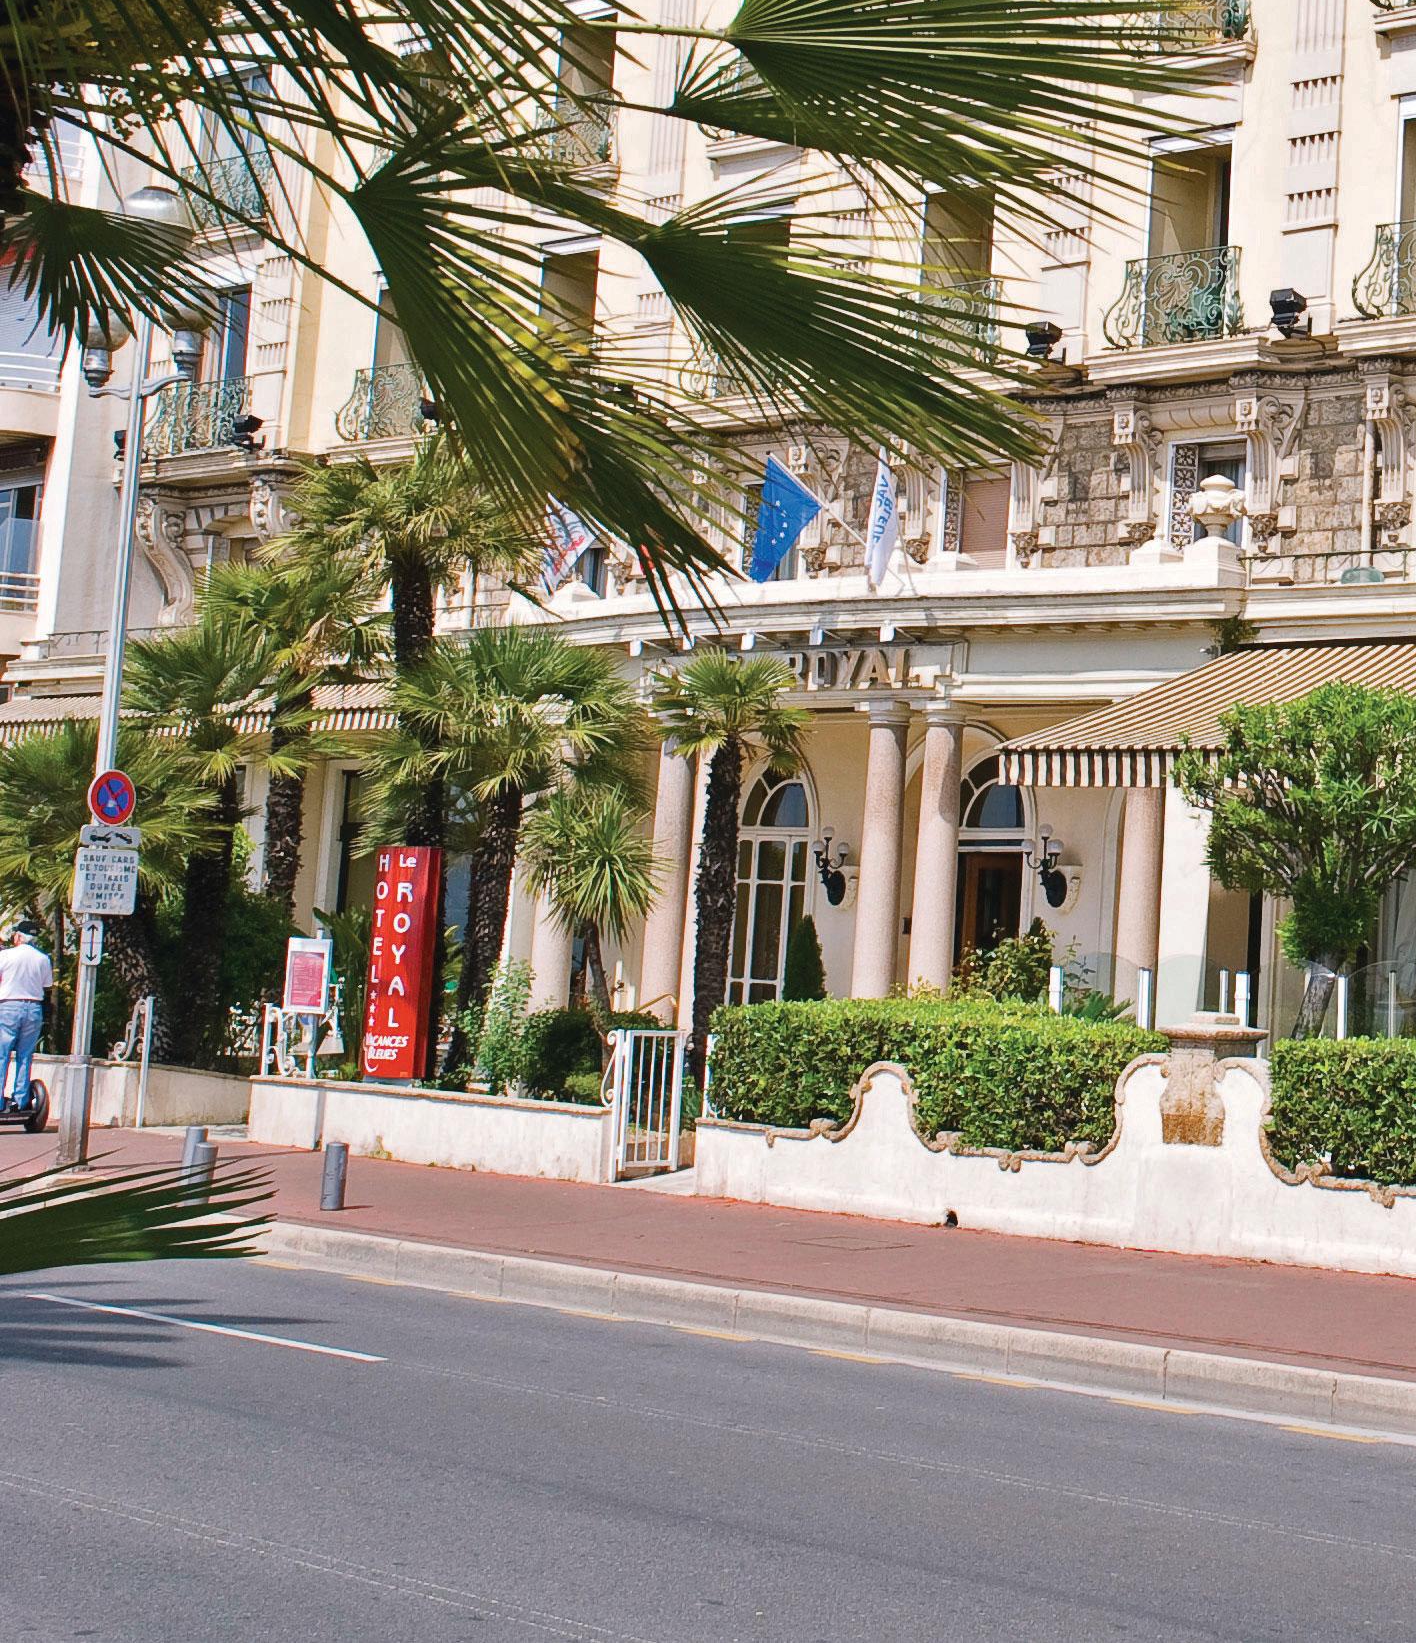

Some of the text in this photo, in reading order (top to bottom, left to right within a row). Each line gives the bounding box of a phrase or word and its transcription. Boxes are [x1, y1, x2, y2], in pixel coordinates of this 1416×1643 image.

[785, 648, 920, 689] ROYAL
[371, 853, 390, 983] HOTEL
[388, 853, 417, 1028] Le ROYAL
